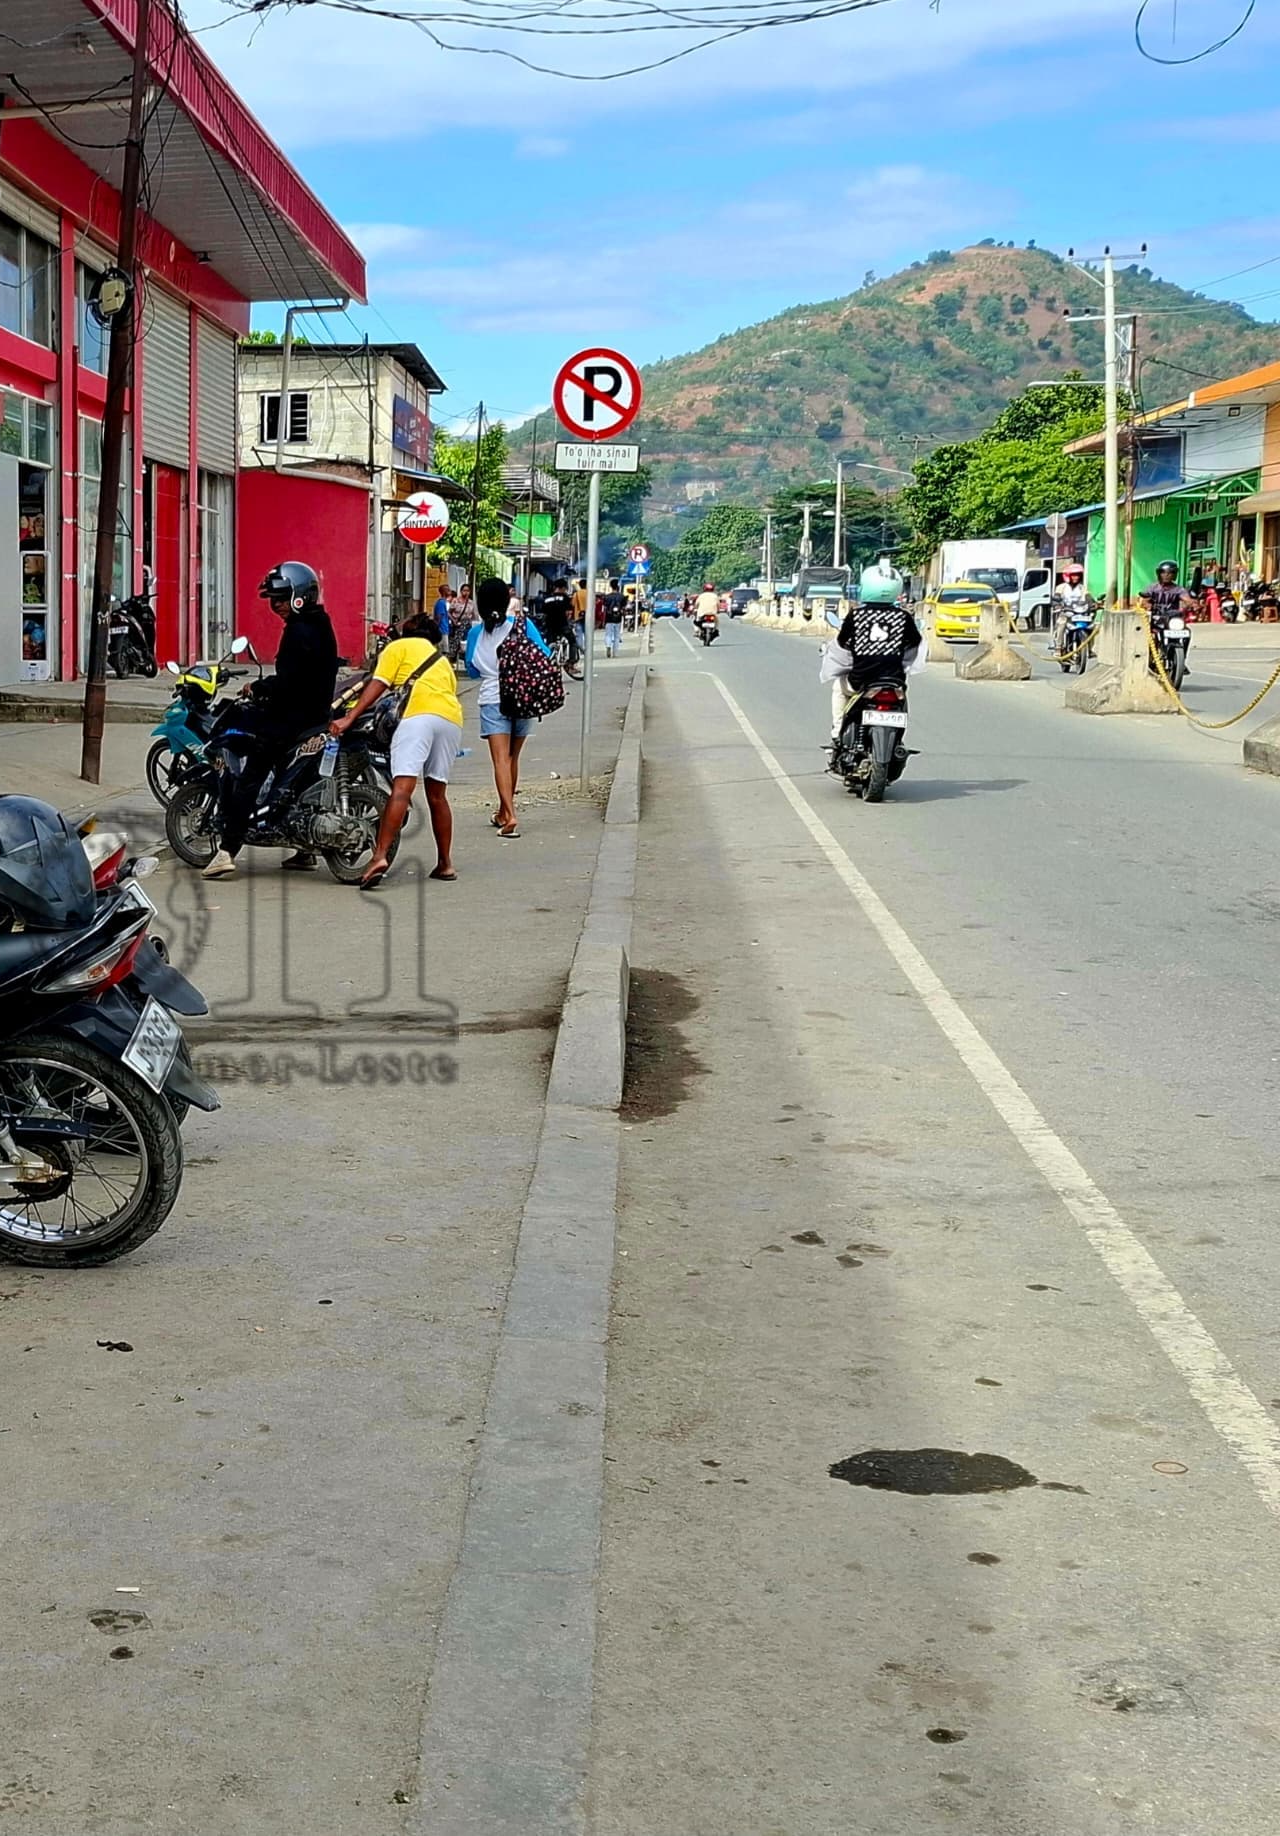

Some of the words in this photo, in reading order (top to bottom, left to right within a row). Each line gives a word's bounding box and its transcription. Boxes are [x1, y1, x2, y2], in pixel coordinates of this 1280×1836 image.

[587, 446, 602, 457] iha
[606, 447, 631, 458] sinal
[577, 459, 595, 469] tuir
[600, 459, 617, 469] mai
[403, 519, 443, 529] BINTANG
